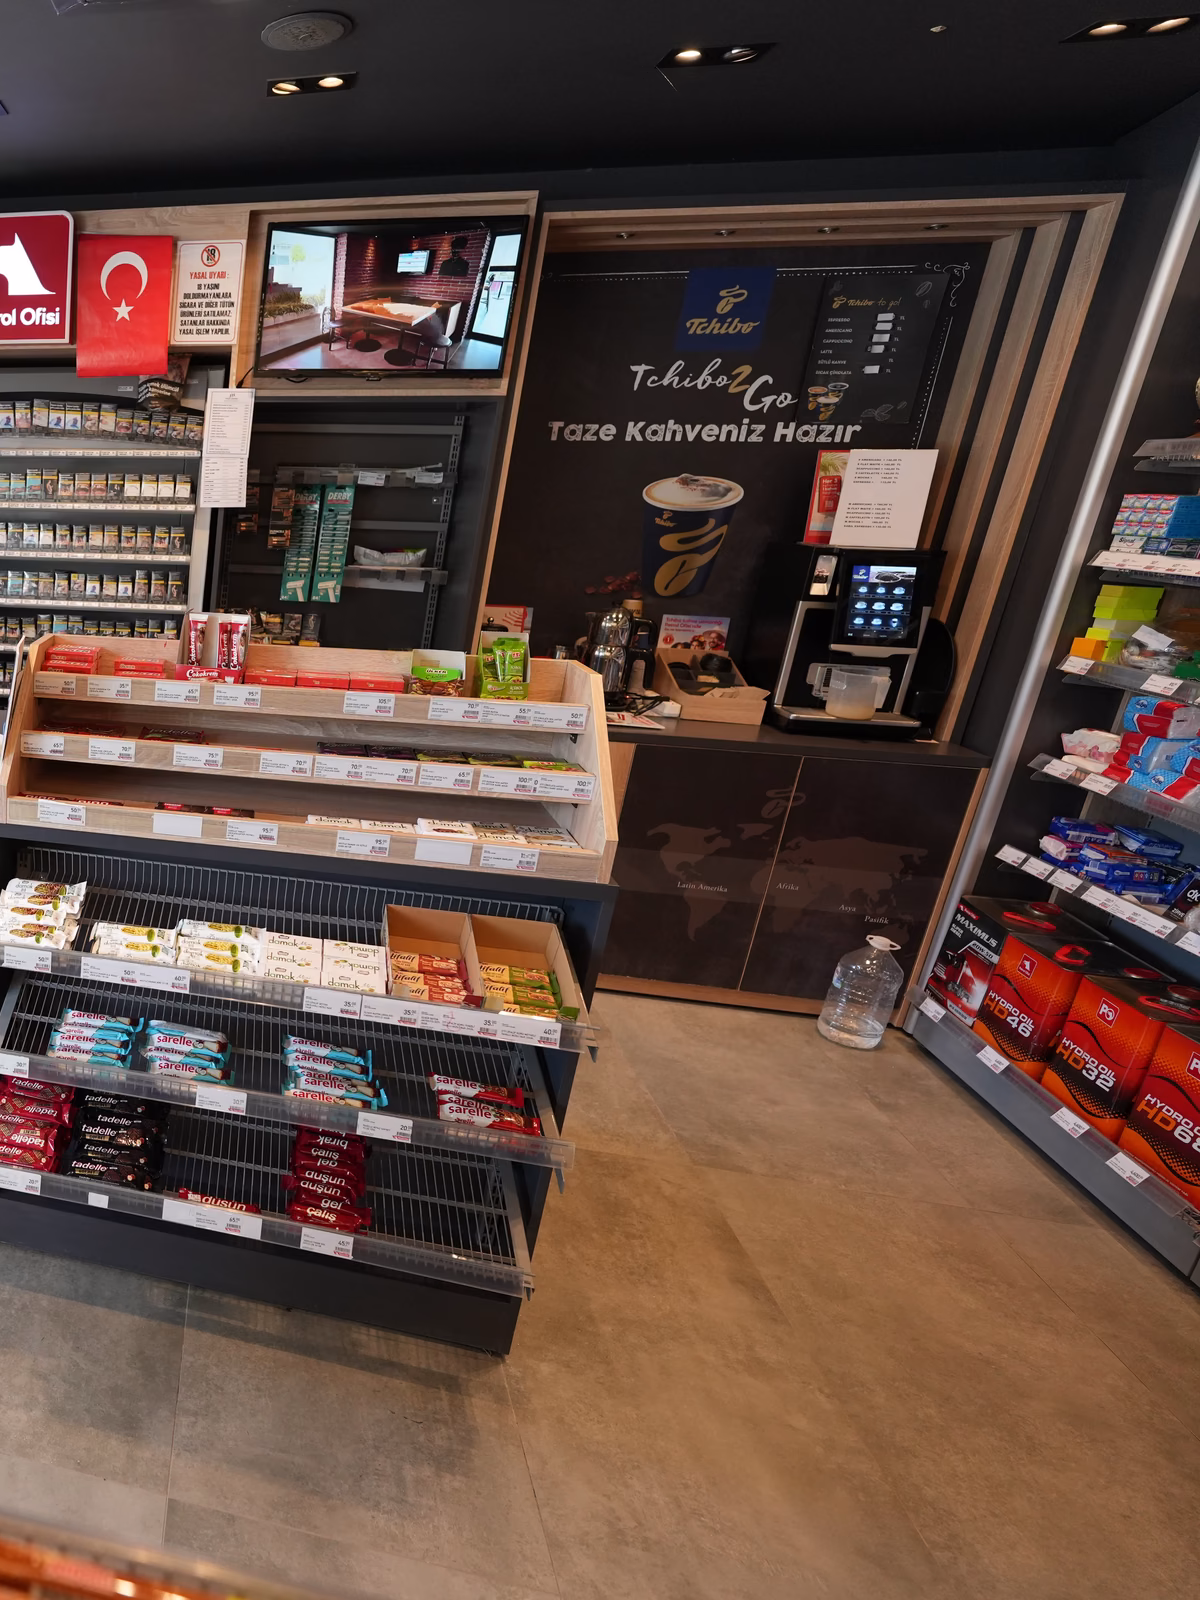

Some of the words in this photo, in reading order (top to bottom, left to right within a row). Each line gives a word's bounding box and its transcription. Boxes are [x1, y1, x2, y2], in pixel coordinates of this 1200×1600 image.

[190, 271, 207, 279] YASAL
[219, 300, 235, 308] TÜTÜN
[20, 306, 60, 326] Ofisi
[195, 327, 210, 336] İŞLEM
[686, 317, 760, 335] Tchibo
[548, 421, 616, 442] Taze
[625, 418, 766, 443] Kahveniz
[773, 422, 862, 443] Hazır
[328, 492, 352, 500] DERBY
[315, 817, 353, 825] damak
[428, 820, 467, 828] damak
[479, 833, 521, 841] damak
[677, 881, 696, 890] Latin
[698, 883, 728, 893] Amerika
[776, 882, 799, 891] Afrika
[838, 904, 856, 913] Asya
[864, 915, 889, 925] Pasifik
[951, 923, 964, 934] SUPER
[955, 913, 999, 948] MAXIMUS
[268, 936, 299, 948] damak
[348, 945, 380, 957] damak
[972, 942, 994, 959] 20W-50
[267, 952, 297, 964] damak
[264, 968, 295, 980] damak
[348, 962, 380, 974] damak
[328, 977, 360, 989] damak
[988, 990, 1021, 1015] HYDRO
[1019, 1013, 1035, 1029] OIL
[71, 1011, 107, 1021] sarelle
[984, 994, 1033, 1038] HD46
[60, 1034, 96, 1043] sarelle
[157, 1035, 193, 1047] sarelle
[292, 1038, 331, 1050] sarelle
[295, 1054, 334, 1067] sarelle
[1062, 1036, 1099, 1067] HYDRO
[1098, 1064, 1117, 1082] OIL
[158, 1062, 195, 1073] sarelle
[1055, 1043, 1115, 1092] HD32
[12, 1077, 44, 1090] tadelle
[304, 1078, 345, 1091] sarelle
[437, 1077, 478, 1089] sarelle
[84, 1094, 118, 1105] tadelle
[292, 1090, 333, 1103] sarelle
[448, 1105, 492, 1119] sarelle
[1144, 1093, 1193, 1128] HYDRO
[97, 1114, 132, 1126] tadelle
[81, 1124, 117, 1137] tadelle
[11, 1133, 45, 1148] tadelle
[84, 1144, 119, 1156] tadelle
[71, 1160, 107, 1172] tadelle
[321, 1198, 342, 1210] gel
[306, 1206, 337, 1222] çalış
